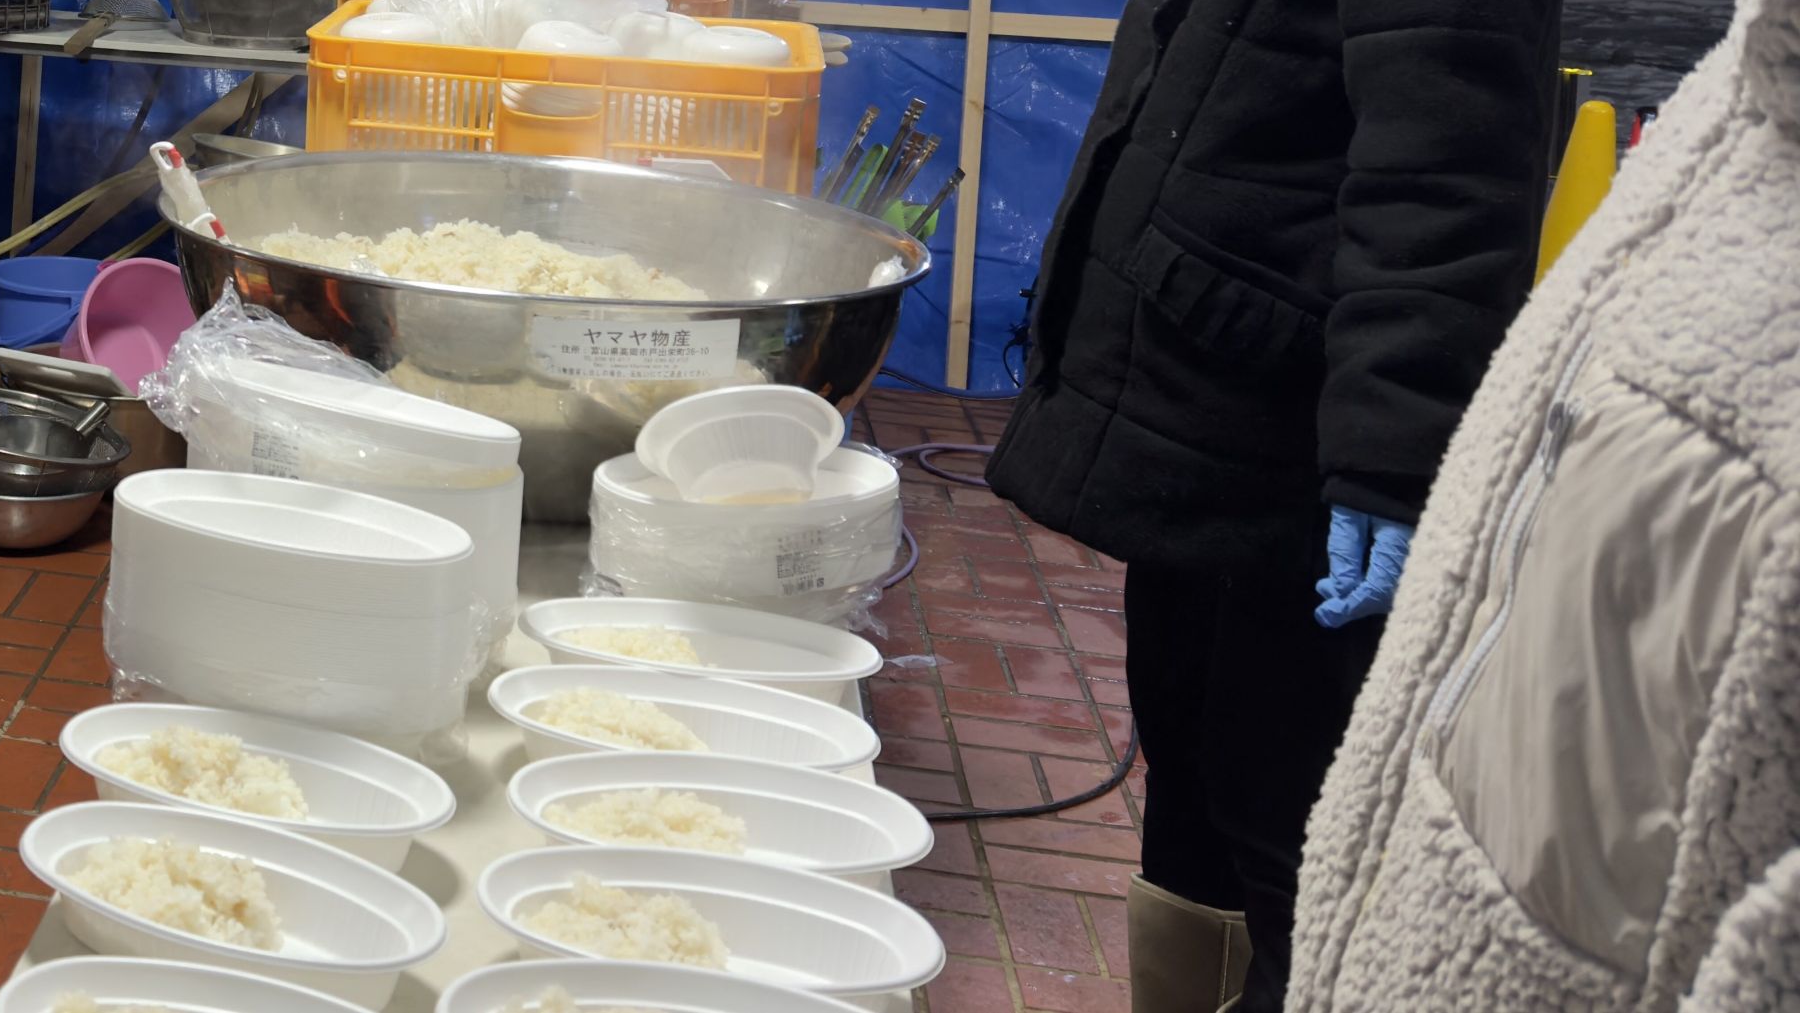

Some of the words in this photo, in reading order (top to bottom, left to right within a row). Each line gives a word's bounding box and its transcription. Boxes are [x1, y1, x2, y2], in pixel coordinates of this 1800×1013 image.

[583, 328, 692, 347] ヤマヤ物産
